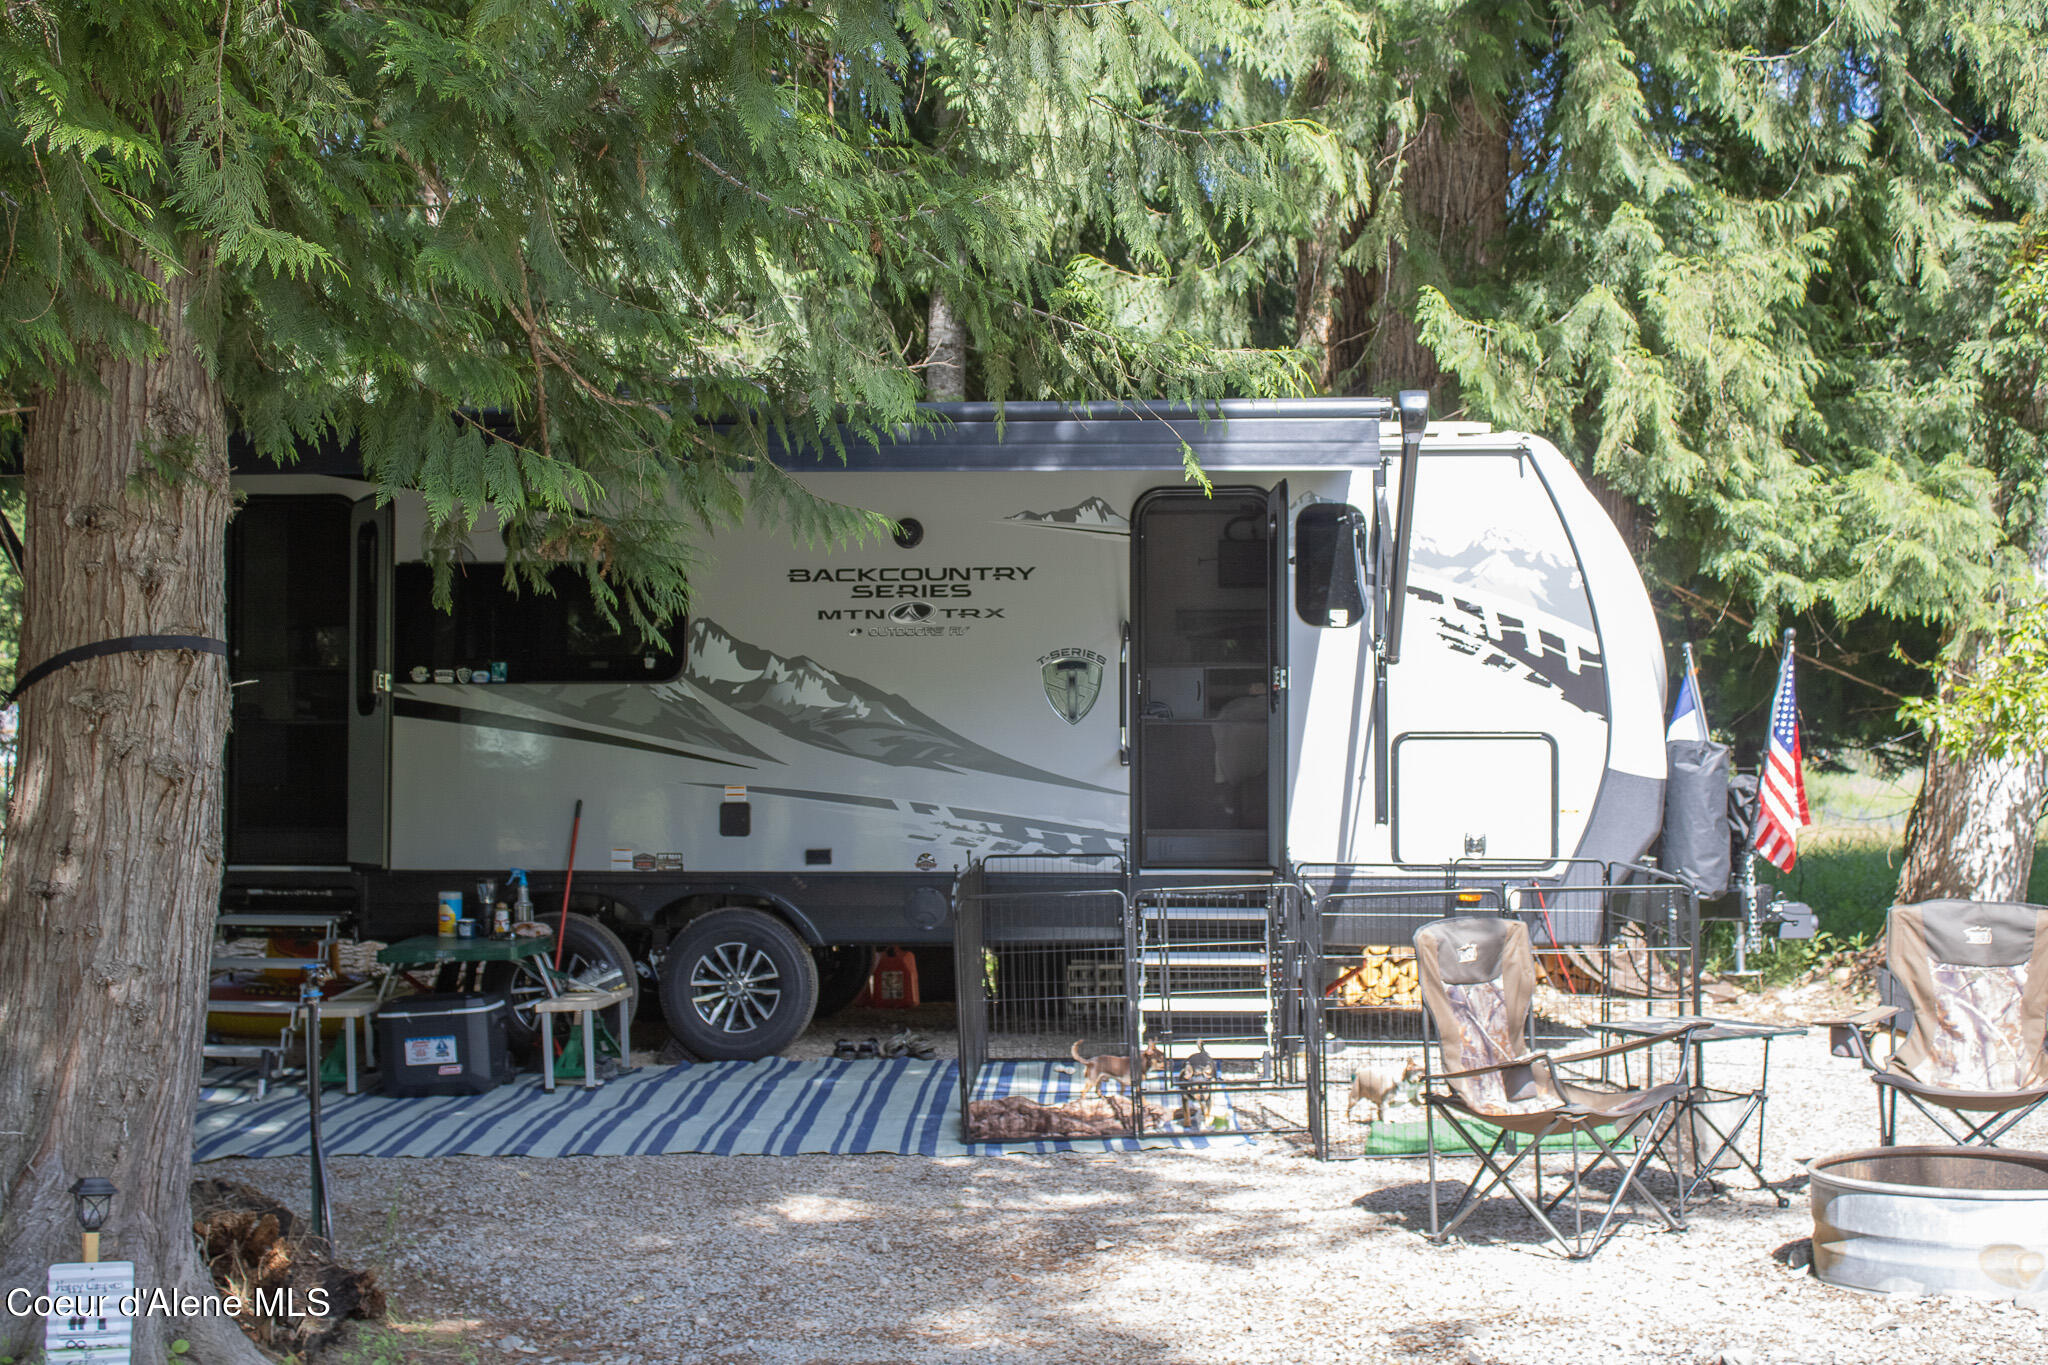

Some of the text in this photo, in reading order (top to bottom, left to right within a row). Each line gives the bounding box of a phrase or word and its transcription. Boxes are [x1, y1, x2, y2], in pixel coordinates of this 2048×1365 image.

[787, 566, 1037, 583] BACKCOUNTRY
[850, 584, 972, 599] SERIES
[818, 608, 1005, 621] MTN TRX
[1036, 647, 1108, 666] T-SERIES
